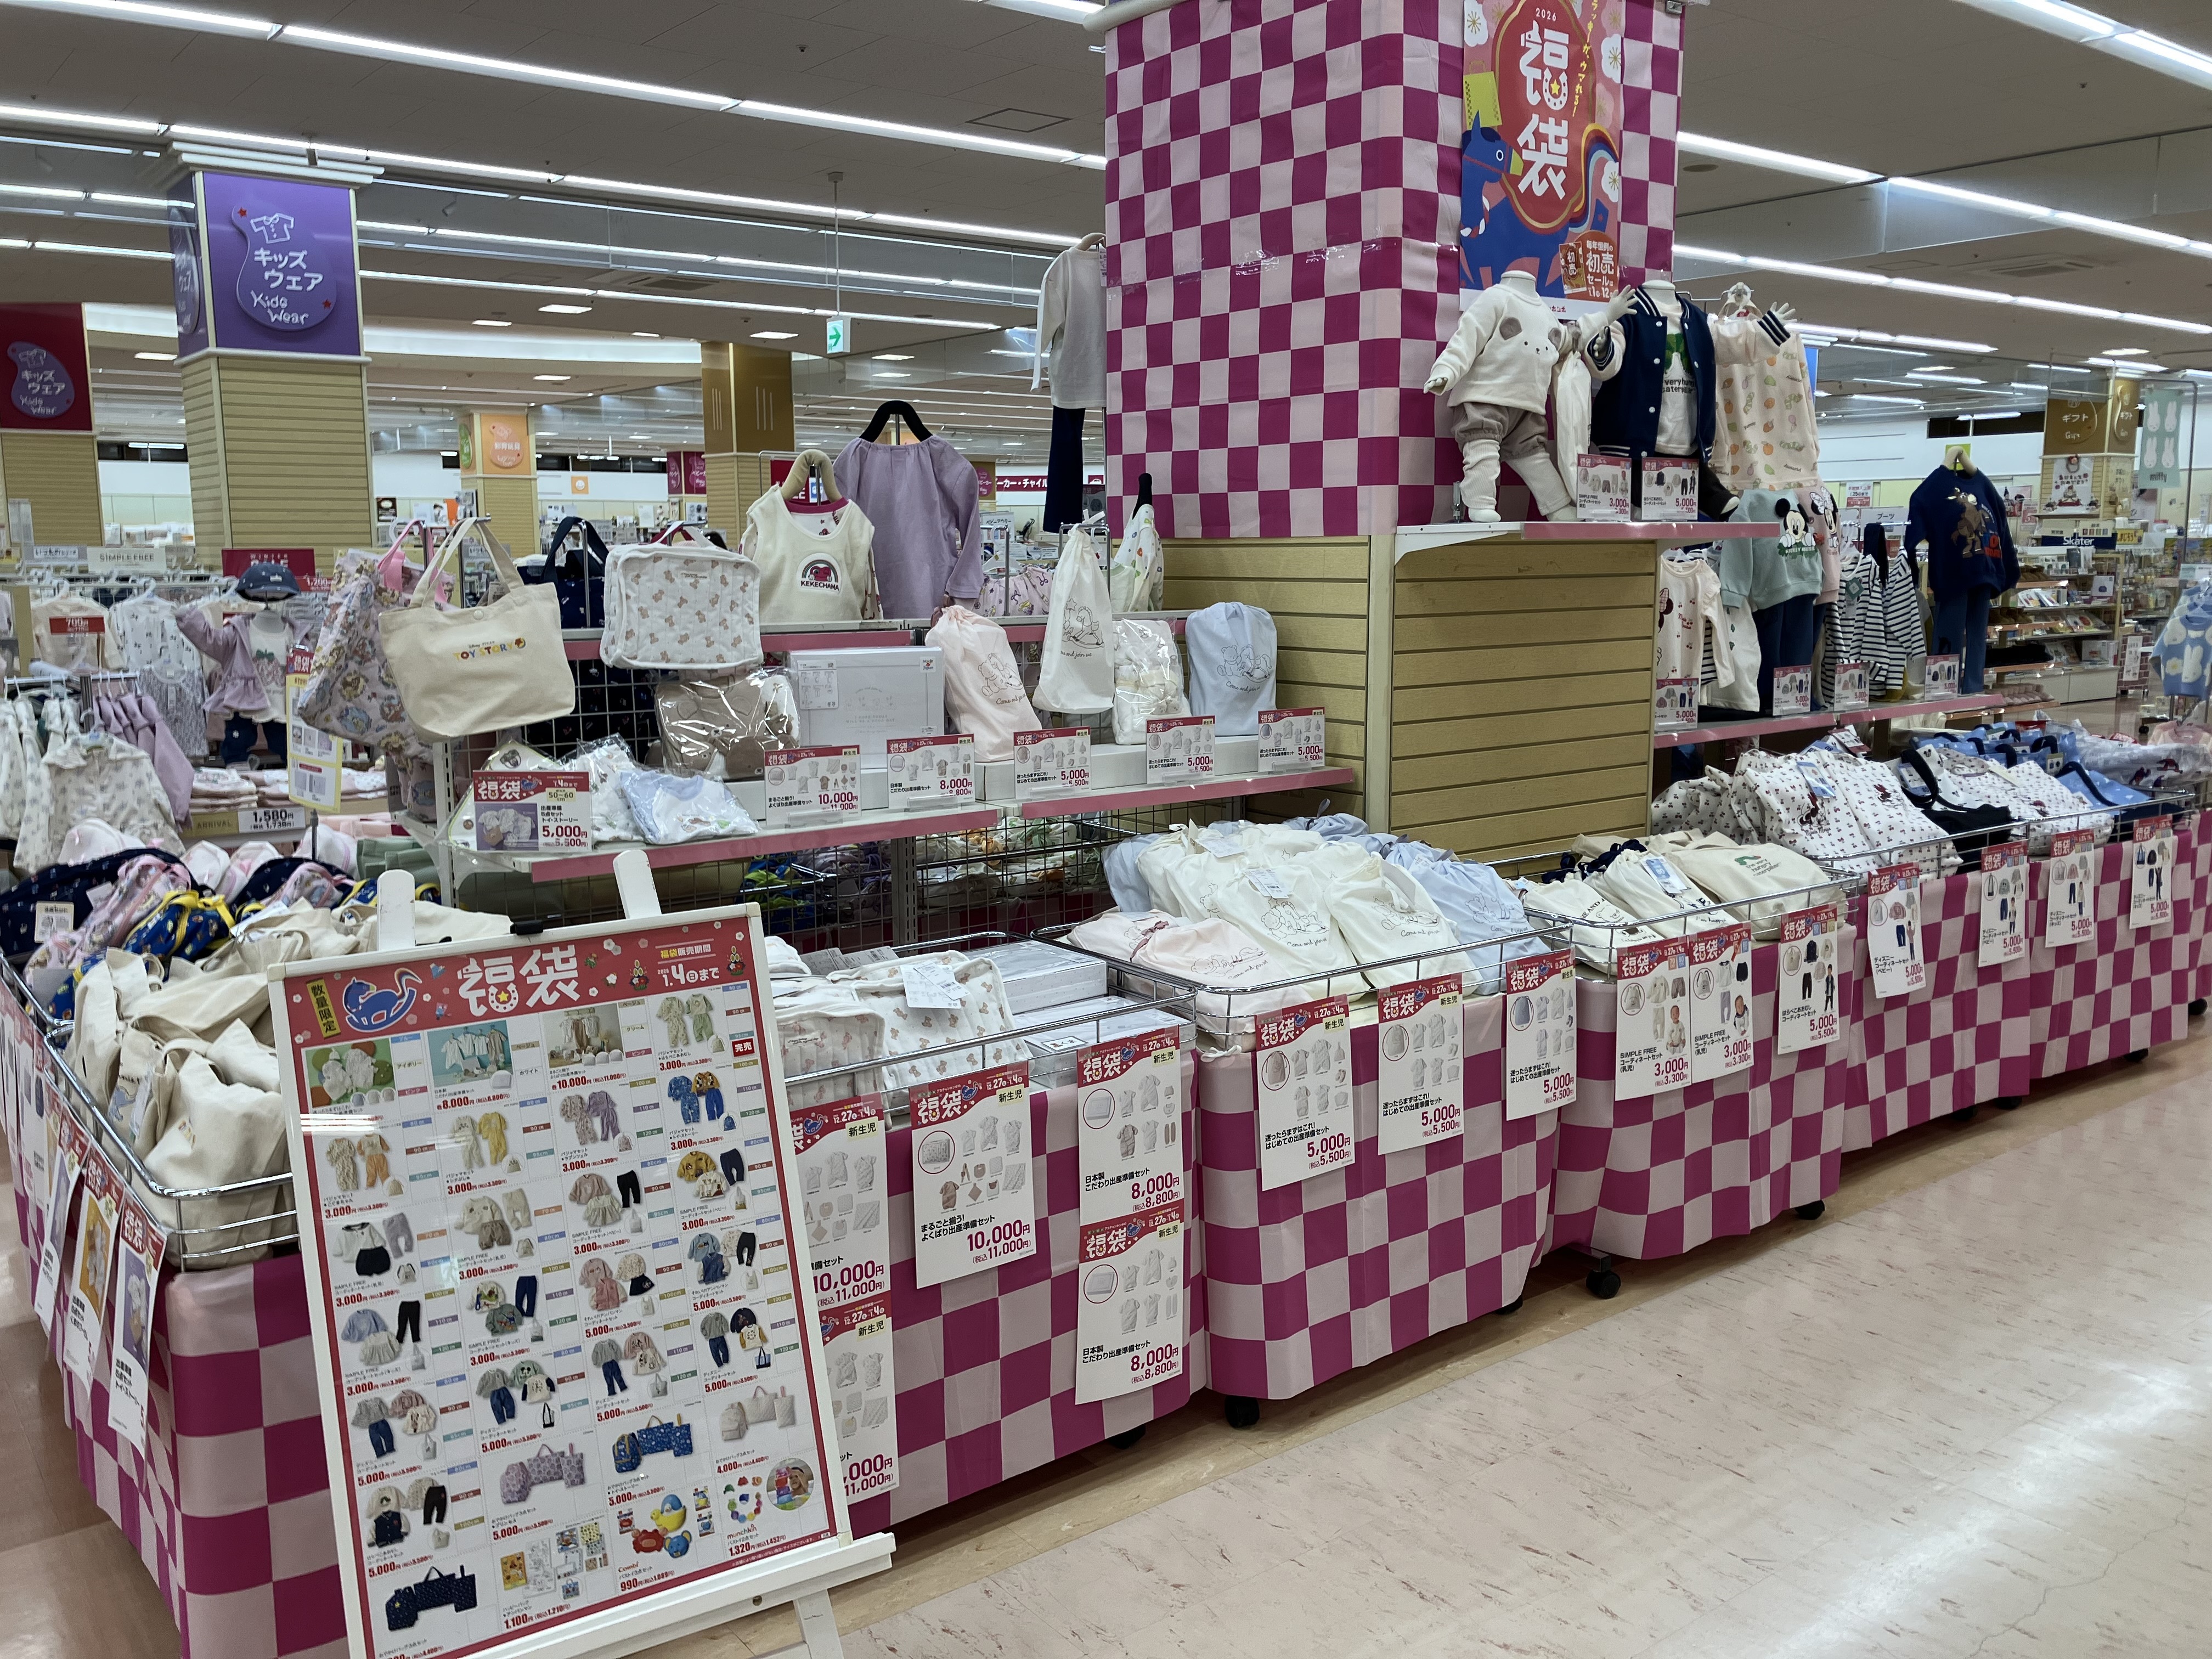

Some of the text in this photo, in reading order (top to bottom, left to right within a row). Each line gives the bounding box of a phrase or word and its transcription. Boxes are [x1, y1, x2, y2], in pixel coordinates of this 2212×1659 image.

[1536, 8, 1556, 22] 2026
[1517, 20, 1569, 200] 福袋
[1587, 240, 1613, 252] 毎年恒例の
[254, 249, 307, 269] キッズ
[1586, 251, 1614, 274] 初売
[264, 272, 323, 291] ウェア
[1587, 274, 1613, 286] セールは
[251, 291, 288, 308] Kids
[268, 308, 309, 325] Wear
[21, 370, 54, 382] キッズ
[28, 382, 65, 394] ウェア
[2062, 414, 2089, 422] ギフト
[2149, 472, 2167, 483] miffy
[2063, 536, 2095, 546] Skater
[800, 580, 839, 591] KEKECHAMA
[453, 642, 514, 661] TOY STORY
[1298, 746, 1323, 755] 5,000円
[1188, 756, 1214, 766] 5,000円
[1061, 769, 1089, 780] 5,000円
[478, 780, 521, 800] 福袋
[940, 778, 973, 789] 8,000円
[818, 792, 858, 804] 10,000円
[542, 826, 588, 838] 5,000円
[1870, 874, 1890, 894] 福袋
[1784, 919, 1805, 940] 福袋
[2072, 918, 2092, 930] 5,000円
[2003, 935, 2023, 948] 5,000円
[660, 944, 711, 959] 福袋販売期間
[1692, 939, 1718, 962] 福袋
[1622, 953, 1649, 978] 福袋
[1906, 962, 1923, 978] 5,000円
[457, 944, 580, 1017] 福袋
[1510, 966, 1539, 991] 福袋
[1383, 996, 1414, 1020] 福袋
[1440, 995, 1458, 1006] 新生児
[311, 984, 336, 1034] 数量限定
[1782, 1005, 1812, 1017] はらぺこあおむし
[1782, 1009, 1817, 1022] コーディネートセット
[1325, 1018, 1344, 1030] 新生児
[1810, 1014, 1837, 1031] 5,000円
[1261, 1017, 1295, 1048] 福袋
[1695, 1030, 1725, 1042] SIMPLE FREE
[735, 1041, 753, 1053] 完売
[1695, 1035, 1731, 1048] コーディネートセット
[1724, 1039, 1751, 1058] 3,000円
[1153, 1051, 1174, 1064] 新生児
[1620, 1047, 1657, 1059] SIMPLE FREE
[1620, 1052, 1663, 1065] コーディネートセット
[659, 1059, 686, 1071] 3,000円
[1083, 1052, 1121, 1083] 福袋
[1654, 1057, 1689, 1077] 3,000円
[1510, 1065, 1561, 1084] はじめての出産準備セット
[1543, 1073, 1574, 1093] 5,000円
[998, 1089, 1023, 1103] 新生児
[918, 1090, 962, 1125] 福袋
[1383, 1097, 1442, 1117] はじめての出産準備セット
[1421, 1104, 1460, 1126] 5,000円
[849, 1122, 877, 1137] 新生児
[670, 1138, 697, 1150] 3,000円
[1265, 1126, 1330, 1150] はじめての出産準備セット
[1307, 1132, 1351, 1159] 5,000円
[1085, 1172, 1105, 1184] 日本製
[1085, 1167, 1150, 1192] こだわり出産準備セット
[1131, 1172, 1180, 1200] 8,000円
[682, 1218, 709, 1231] 3,000円
[921, 1215, 995, 1242] よくばり出産準備セット
[967, 1219, 1030, 1252] 10,000円
[693, 1299, 720, 1312] 5,000円
[858, 1320, 884, 1337] 新生児
[1082, 1340, 1151, 1364] こだわり出産準備セット
[1083, 1345, 1104, 1356] 日本製
[1131, 1344, 1179, 1372] 8,000円
[597, 1408, 625, 1423] 5,000円
[716, 1461, 743, 1474] 4,000円
[727, 1523, 758, 1539] munchkin
[729, 1541, 756, 1557] 1,320円
[618, 1561, 639, 1572] Combi
[620, 1578, 643, 1592] 990円
[504, 1613, 534, 1630] 1,100円
